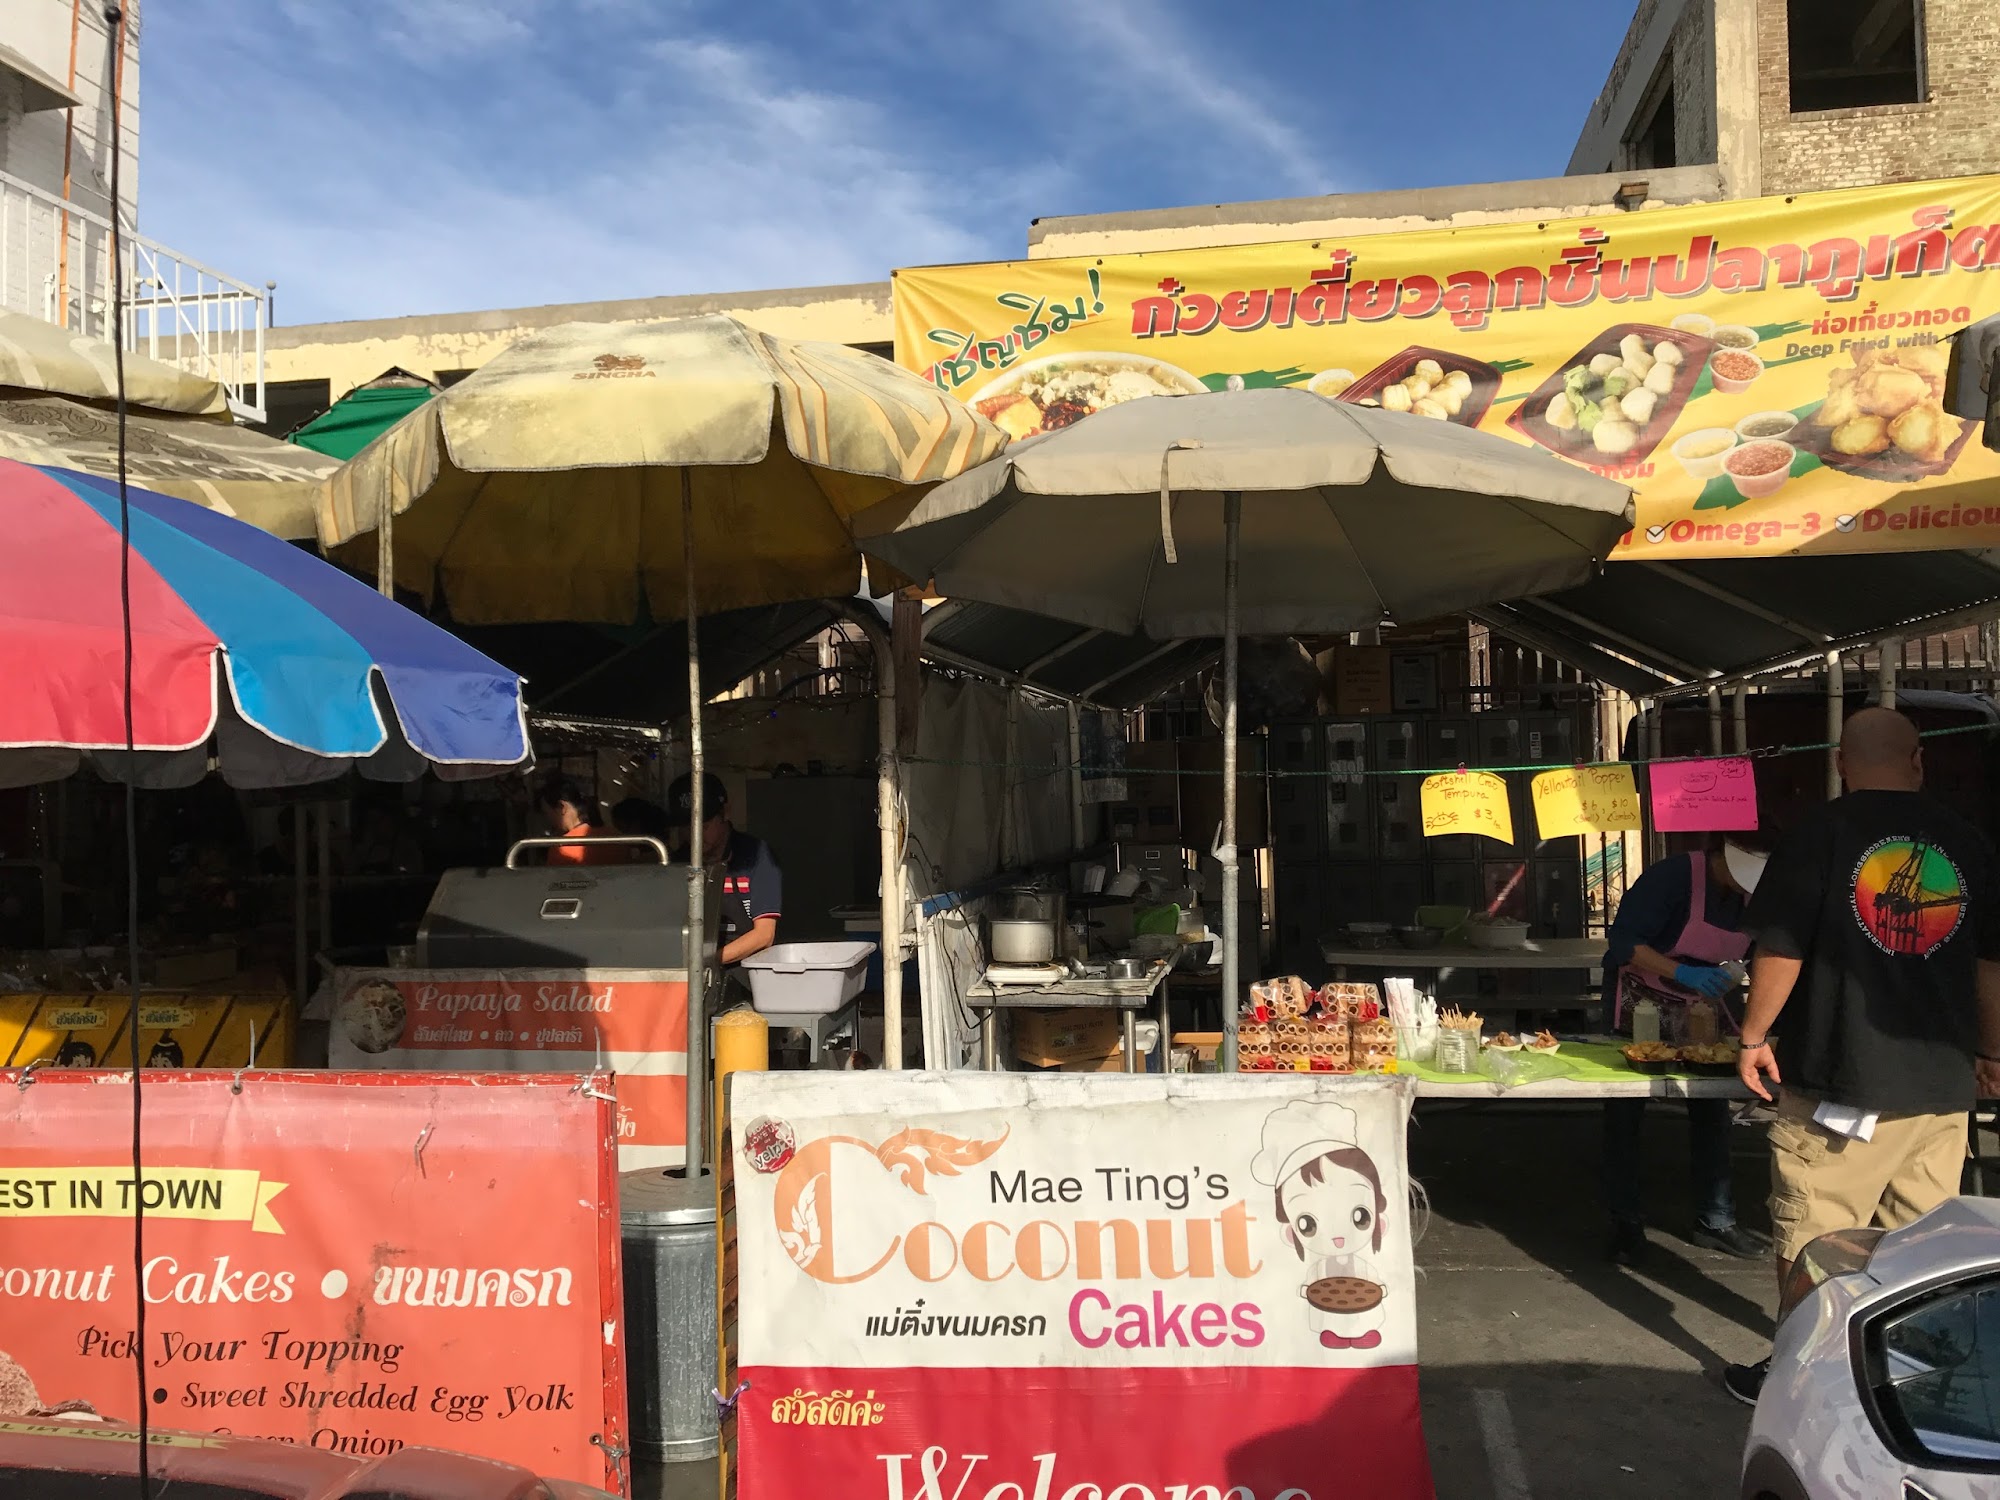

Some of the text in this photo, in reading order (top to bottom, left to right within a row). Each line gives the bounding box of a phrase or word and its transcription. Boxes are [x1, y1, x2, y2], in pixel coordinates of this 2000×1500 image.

[934, 267, 1106, 392] เชิญชิม!
[1786, 341, 1834, 358] Deep
[1839, 335, 1891, 354] Fried
[1896, 331, 1939, 349] with
[571, 370, 657, 380] SINGHA
[1670, 512, 1822, 546] Omega-3
[1862, 503, 2000, 533] Deliciou
[1440, 788, 1489, 803] Tempura
[1588, 767, 1626, 794] Popper
[1849, 892, 1896, 957] INTERNATIONAL
[415, 982, 613, 1019] Papaya Salad
[754, 1143, 782, 1170] yelp
[69, 1179, 103, 1209] IN
[116, 1179, 222, 1210] TOWN
[990, 1169, 1082, 1203] Mae
[774, 1132, 1263, 1285] Coconut
[142, 1256, 296, 1304] Cakes
[373, 1265, 573, 1307] ขนมครก
[865, 1298, 1046, 1337] แม่ติ๋งขนมครก
[1068, 1288, 1265, 1349] Cakes
[77, 1325, 404, 1373] Pick Your Topping
[181, 1381, 574, 1422] Sweet Shredded Egg Yolk
[771, 1387, 886, 1426] สวัสดีค่ะ
